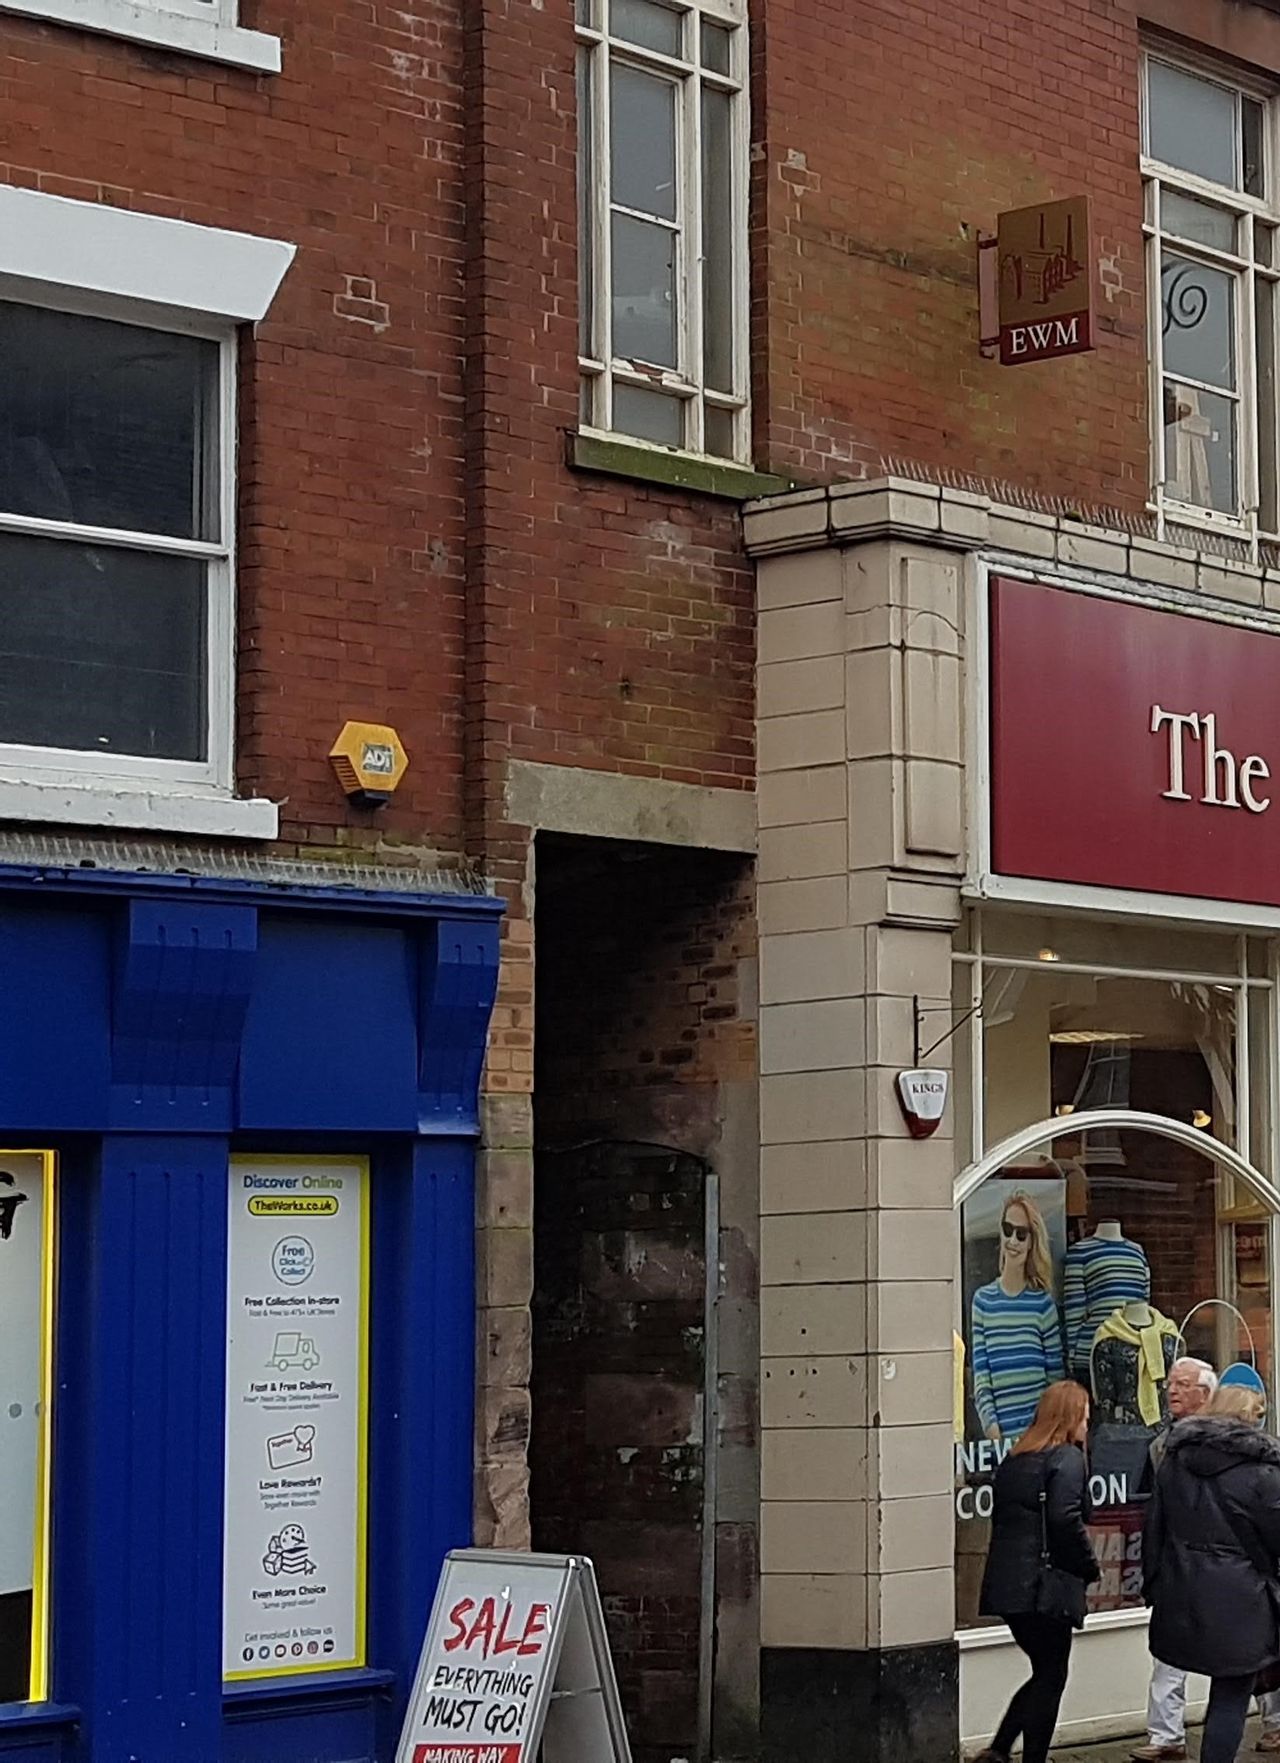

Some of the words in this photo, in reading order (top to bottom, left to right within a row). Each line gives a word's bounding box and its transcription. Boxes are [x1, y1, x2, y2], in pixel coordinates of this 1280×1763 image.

[1010, 317, 1080, 356] EWM
[1150, 704, 1271, 814] The
[912, 1083, 944, 1093] KINGS
[243, 1174, 299, 1189] Discover
[302, 1175, 343, 1189] Online
[255, 1201, 332, 1211] TheWorks.co.uk
[282, 1245, 305, 1256] Free
[265, 1296, 306, 1306] Collection
[299, 1381, 332, 1391] Delivery
[259, 1481, 279, 1490] Love
[298, 1584, 327, 1596] Choice
[444, 1597, 552, 1660] SALE
[433, 1665, 534, 1698] EVERYTHING
[422, 1696, 484, 1732] MUST
[485, 1702, 527, 1736] GO!
[423, 1748, 476, 1763] MAKING
[477, 1747, 508, 1763] WAY
